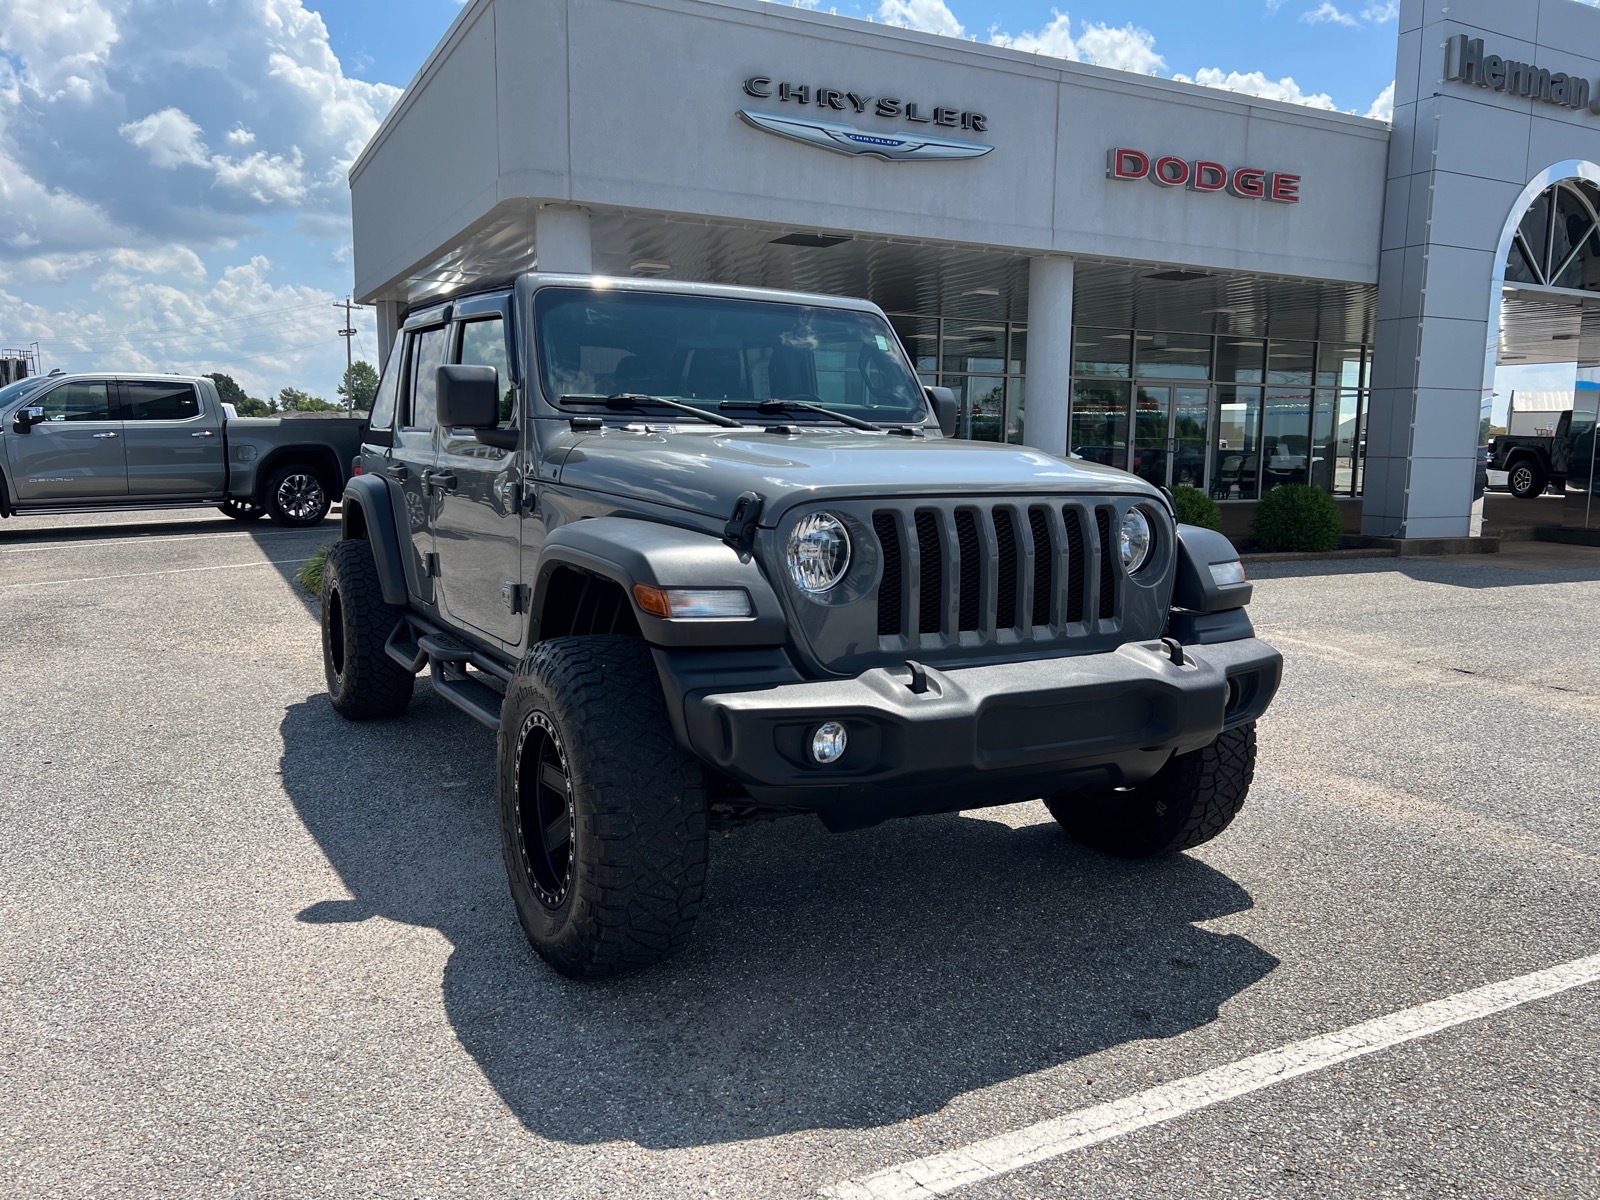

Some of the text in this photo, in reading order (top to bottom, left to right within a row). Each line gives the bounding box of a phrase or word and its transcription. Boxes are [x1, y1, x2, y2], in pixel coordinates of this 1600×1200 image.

[1446, 34, 1590, 110] Herman
[743, 76, 988, 131] CHRYSLER
[850, 134, 899, 146] CHRYSLER
[1106, 147, 1301, 204] DODGE
